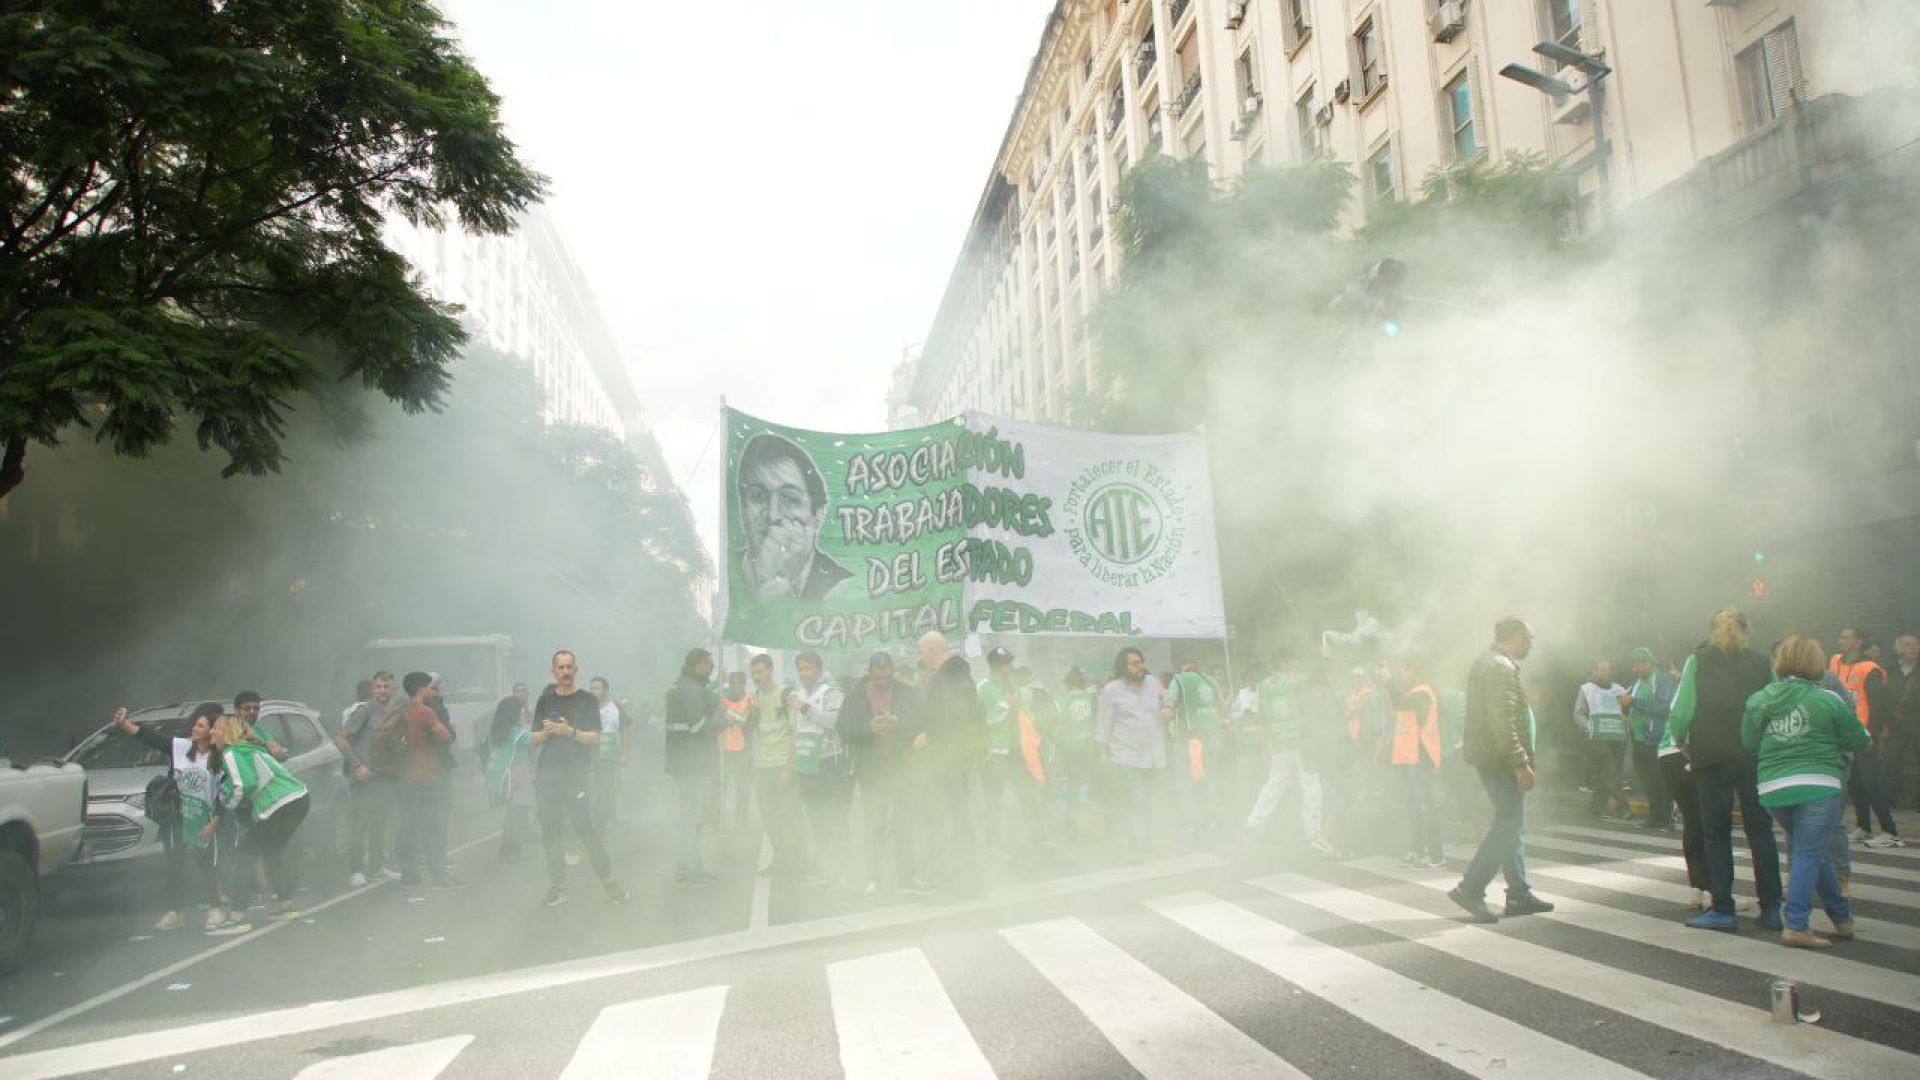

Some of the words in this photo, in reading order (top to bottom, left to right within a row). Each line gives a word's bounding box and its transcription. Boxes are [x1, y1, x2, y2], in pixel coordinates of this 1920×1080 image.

[847, 427, 1024, 494] ASOCIACIÓN
[1063, 459, 1122, 516] Fortalecer
[1126, 460, 1139, 476] el
[837, 483, 1055, 545] TRABAJADORES
[1089, 489, 1156, 560] ATE
[865, 551, 926, 598] DEL
[936, 537, 1034, 587] ESTADO
[1064, 528, 1091, 567] para
[1090, 559, 1138, 587] liberar
[795, 599, 960, 645] CAPITAL
